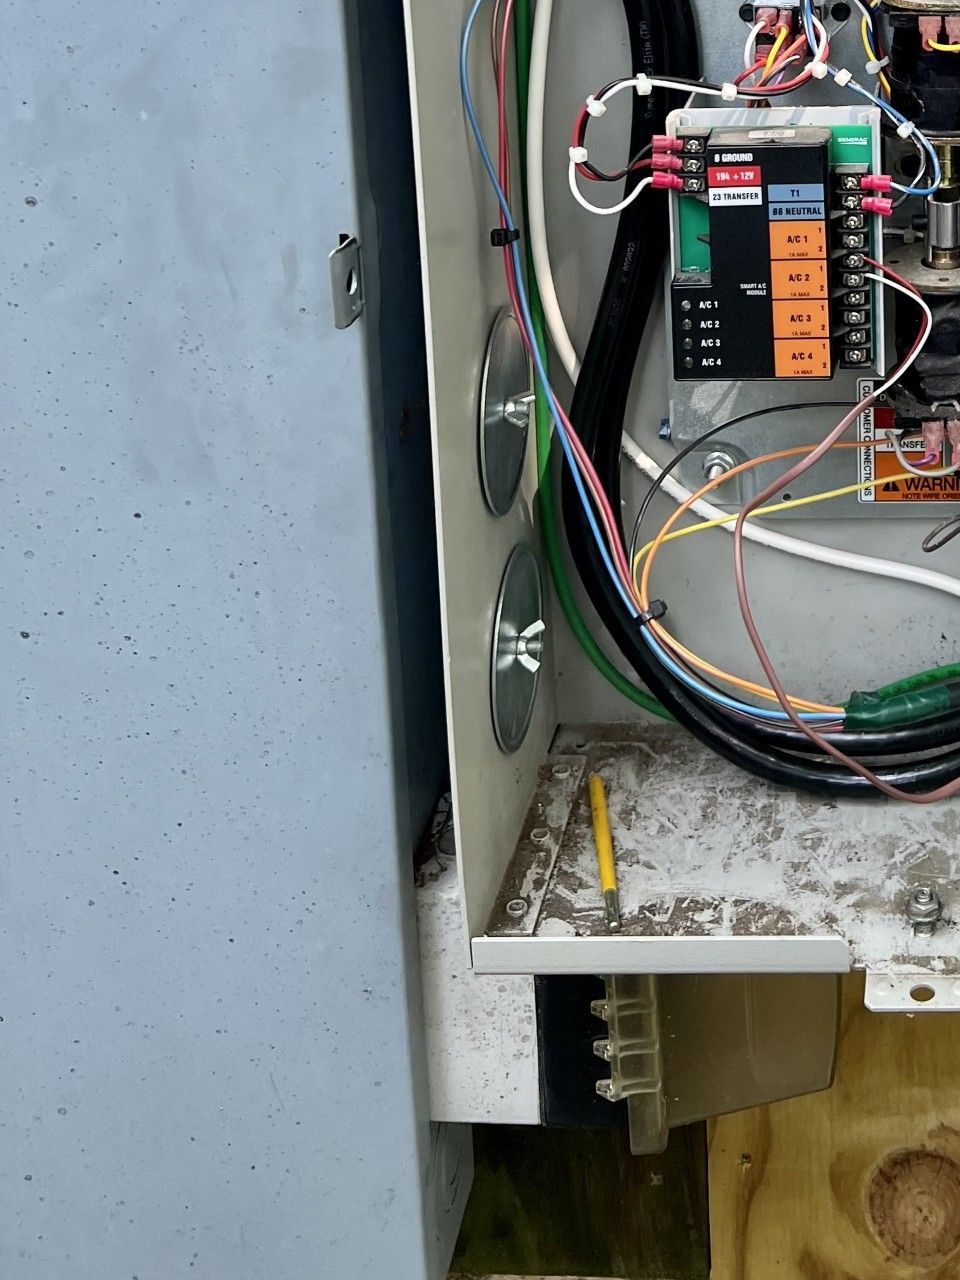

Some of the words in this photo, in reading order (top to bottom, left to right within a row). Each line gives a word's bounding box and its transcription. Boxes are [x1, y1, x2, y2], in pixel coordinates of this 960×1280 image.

[722, 152, 754, 162] GROUND
[790, 190, 800, 198] T1
[785, 207, 822, 215] NEUTRAL
[787, 235, 801, 244] A/C
[788, 274, 802, 282] A/C
[804, 274, 810, 282] 2
[699, 301, 712, 309] A/C
[790, 314, 804, 322] A/C
[700, 320, 712, 328] A/C
[701, 339, 714, 347] A/C
[792, 352, 805, 360] A/C
[862, 385, 871, 434] CUOMER
